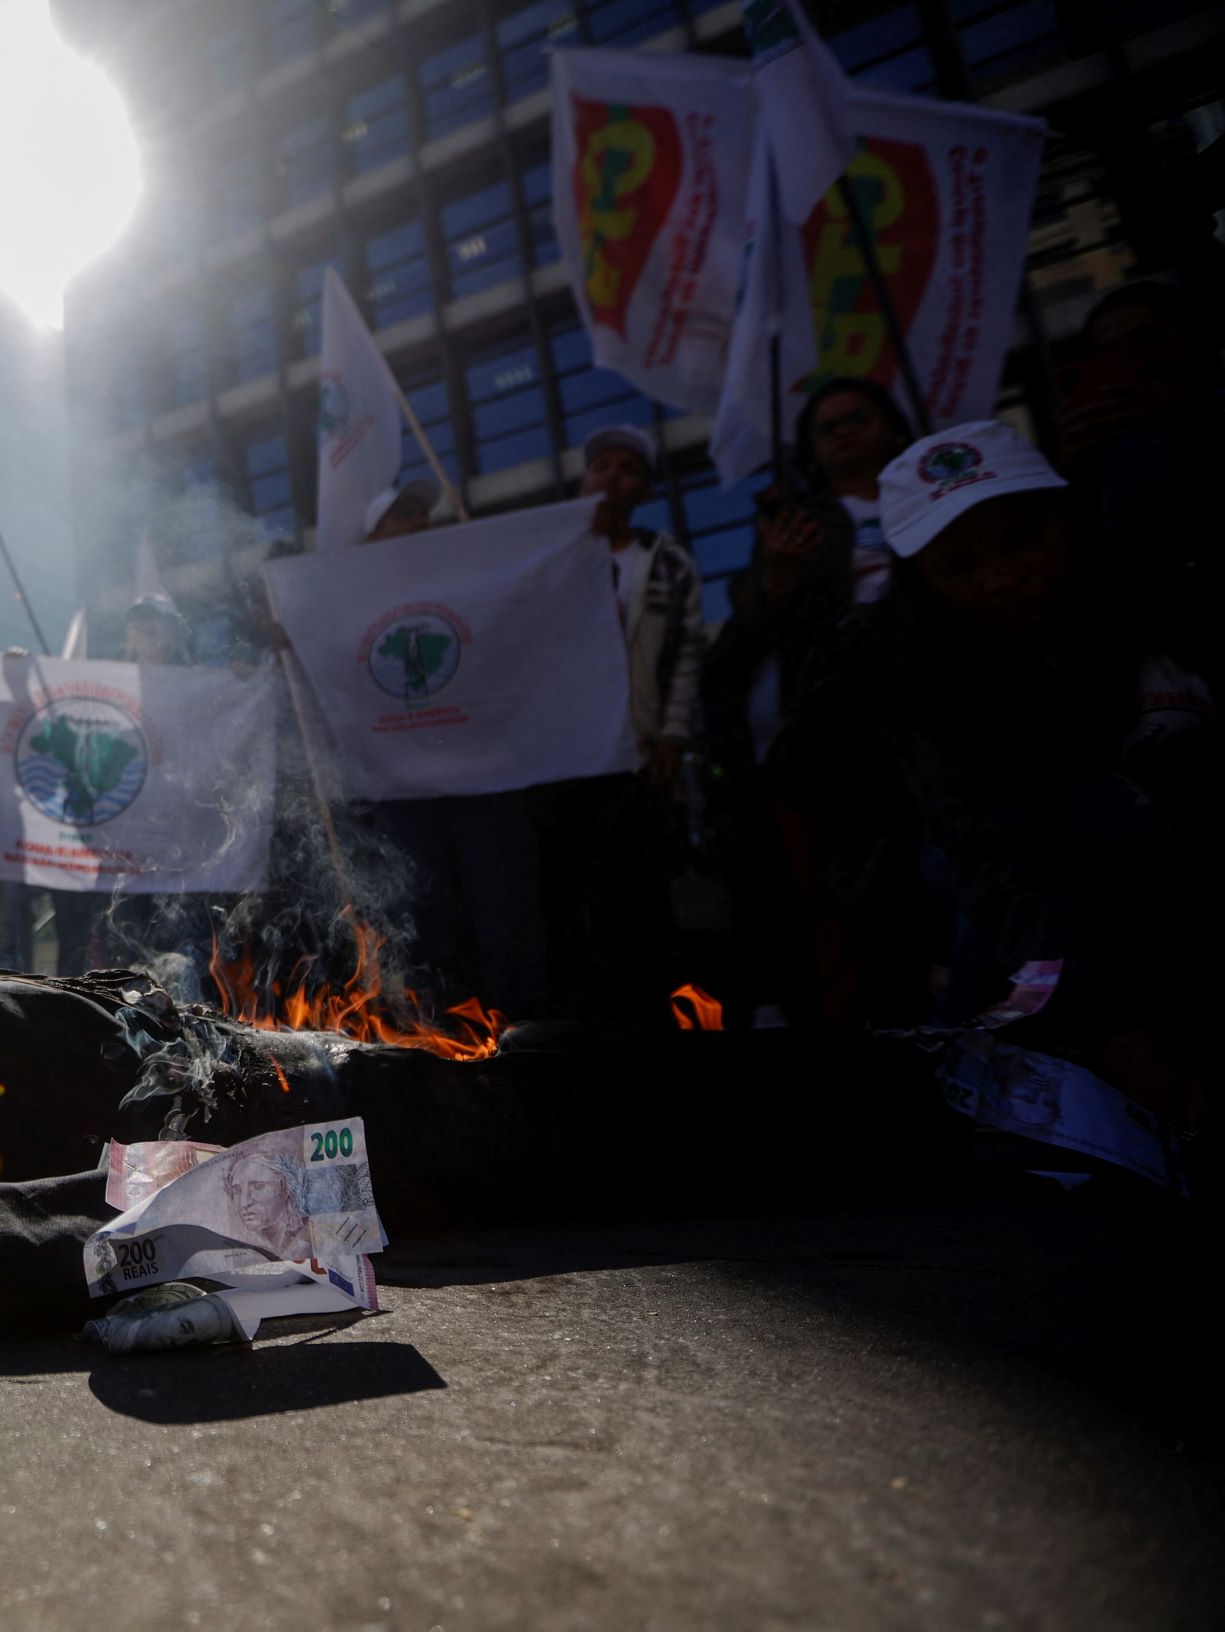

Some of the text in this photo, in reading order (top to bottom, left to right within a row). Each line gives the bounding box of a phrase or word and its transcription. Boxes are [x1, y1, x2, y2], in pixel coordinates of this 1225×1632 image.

[310, 1127, 353, 1162] 200
[118, 1238, 156, 1267] 200
[123, 1262, 159, 1281] REAIS
